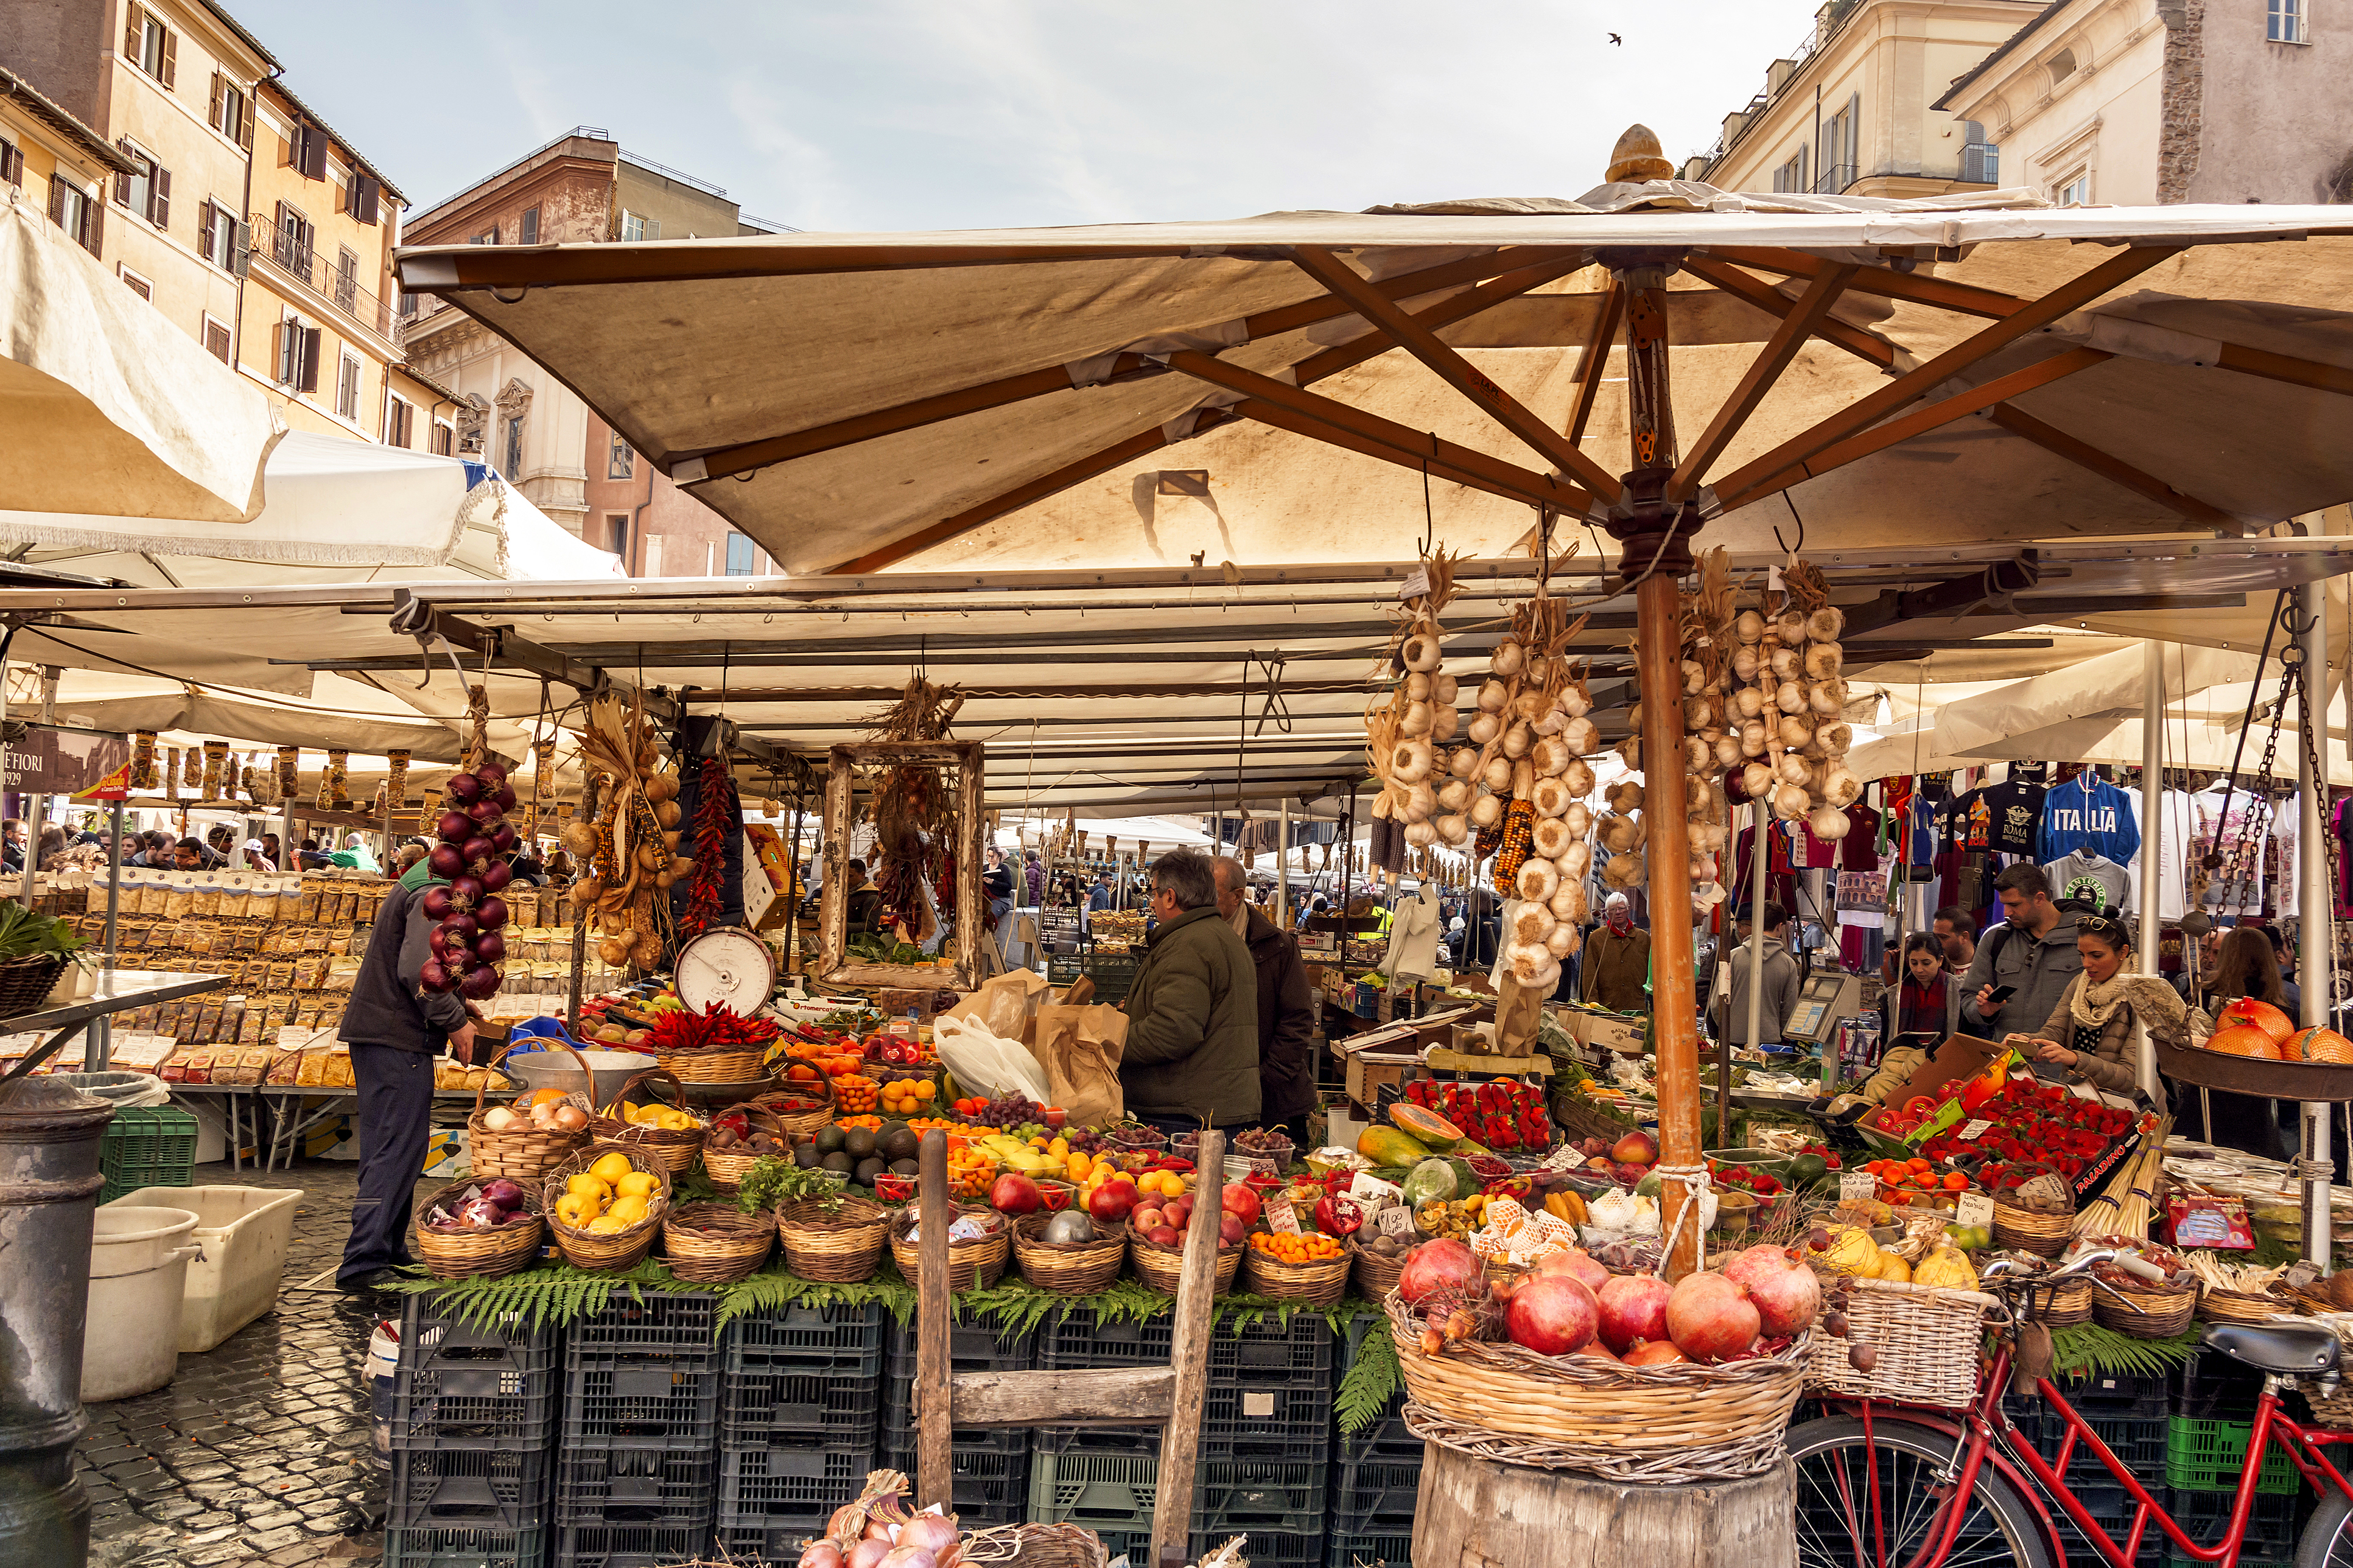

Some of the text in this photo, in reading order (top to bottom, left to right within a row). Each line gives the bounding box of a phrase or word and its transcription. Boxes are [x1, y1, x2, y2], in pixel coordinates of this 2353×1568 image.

[4, 751, 43, 772] E'FIORI
[3, 771, 21, 786] 1929
[2004, 824, 2027, 838] ROMA
[2054, 808, 2117, 833] ITALIA
[2075, 1144, 2127, 1194] PALADINO
